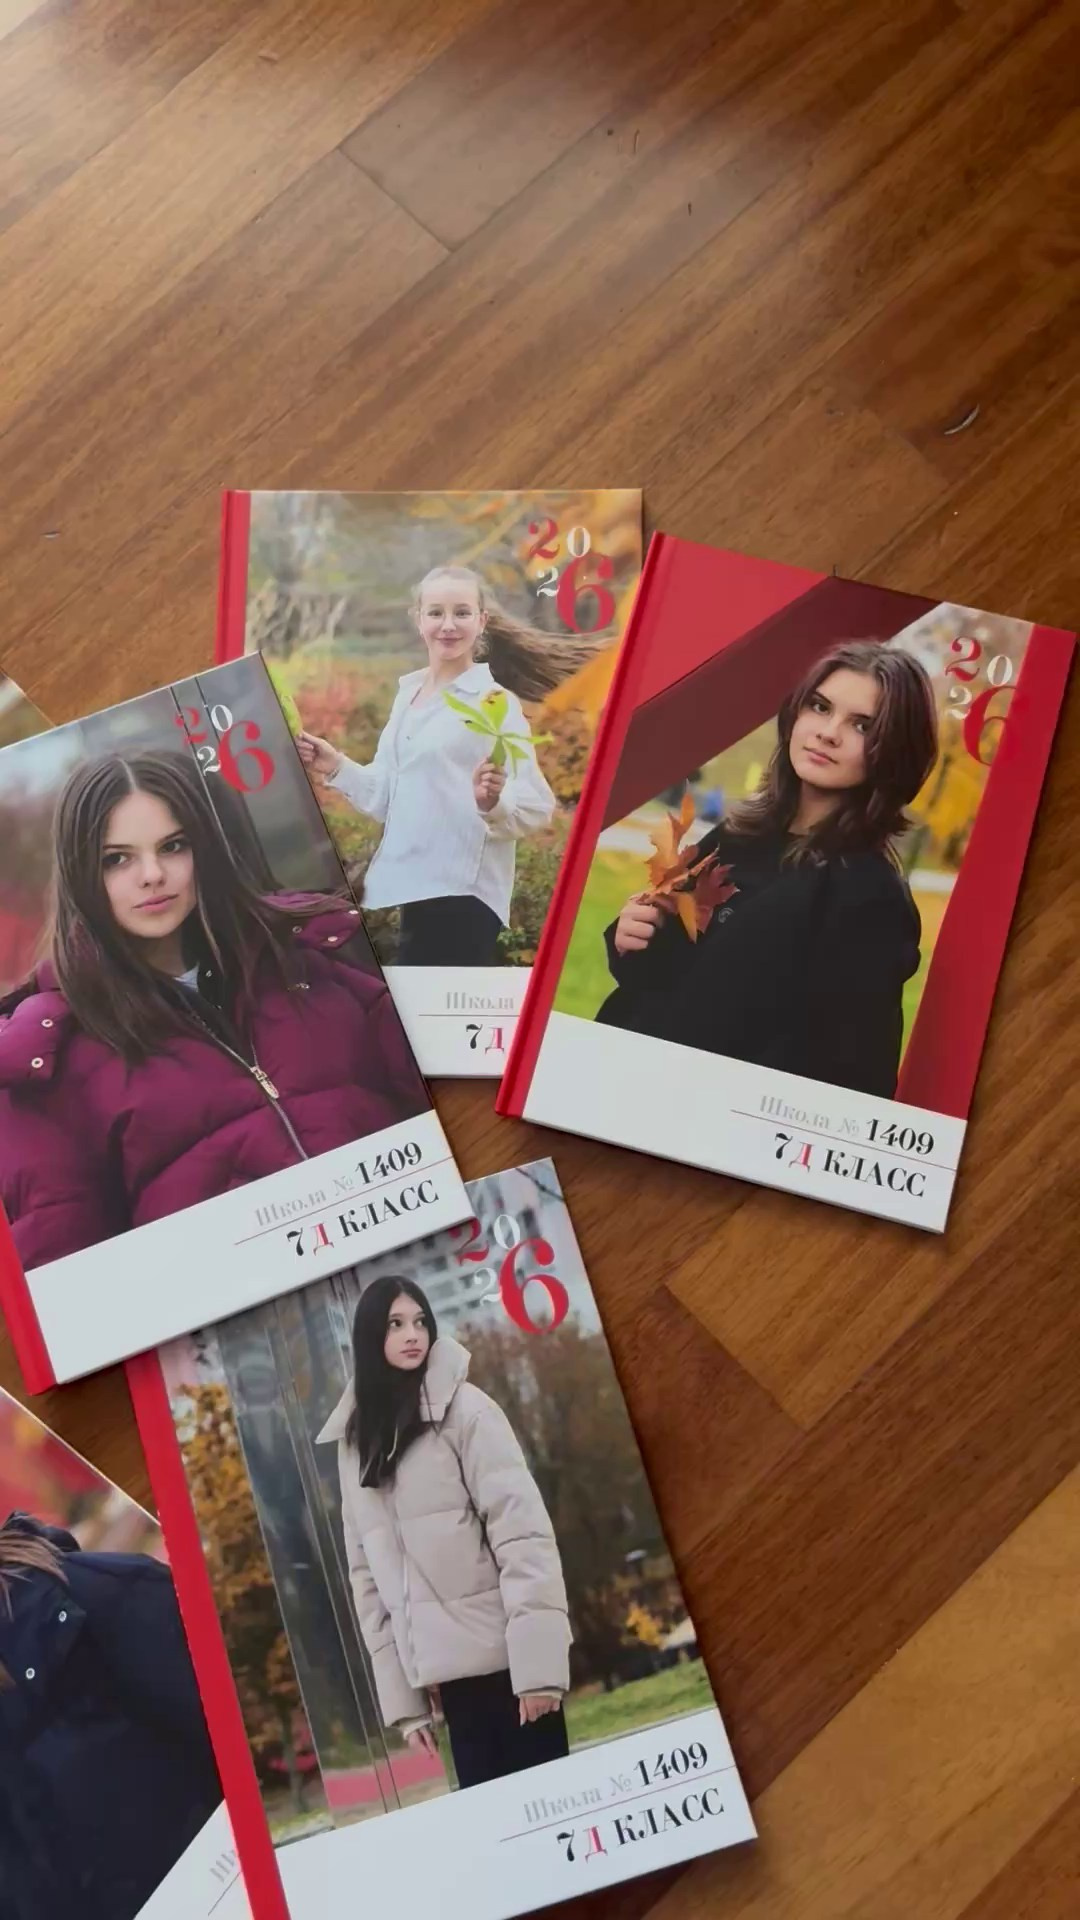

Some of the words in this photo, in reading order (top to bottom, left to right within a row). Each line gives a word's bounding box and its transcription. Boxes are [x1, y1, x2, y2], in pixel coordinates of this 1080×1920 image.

[446, 991, 515, 1010] Школа
[759, 1095, 830, 1129] Школа
[865, 1117, 935, 1156] 1409
[254, 1188, 327, 1227] Школа
[354, 1142, 423, 1186] 1409
[774, 1132, 815, 1173] 7Д
[822, 1148, 927, 1198] КЛАСС
[286, 1222, 335, 1257] 7Д
[336, 1179, 440, 1239] КЛАСС
[523, 1787, 603, 1824] Школа
[632, 1742, 709, 1788] 1409
[556, 1825, 609, 1864] 7Д
[612, 1787, 725, 1847] КЛАСС
